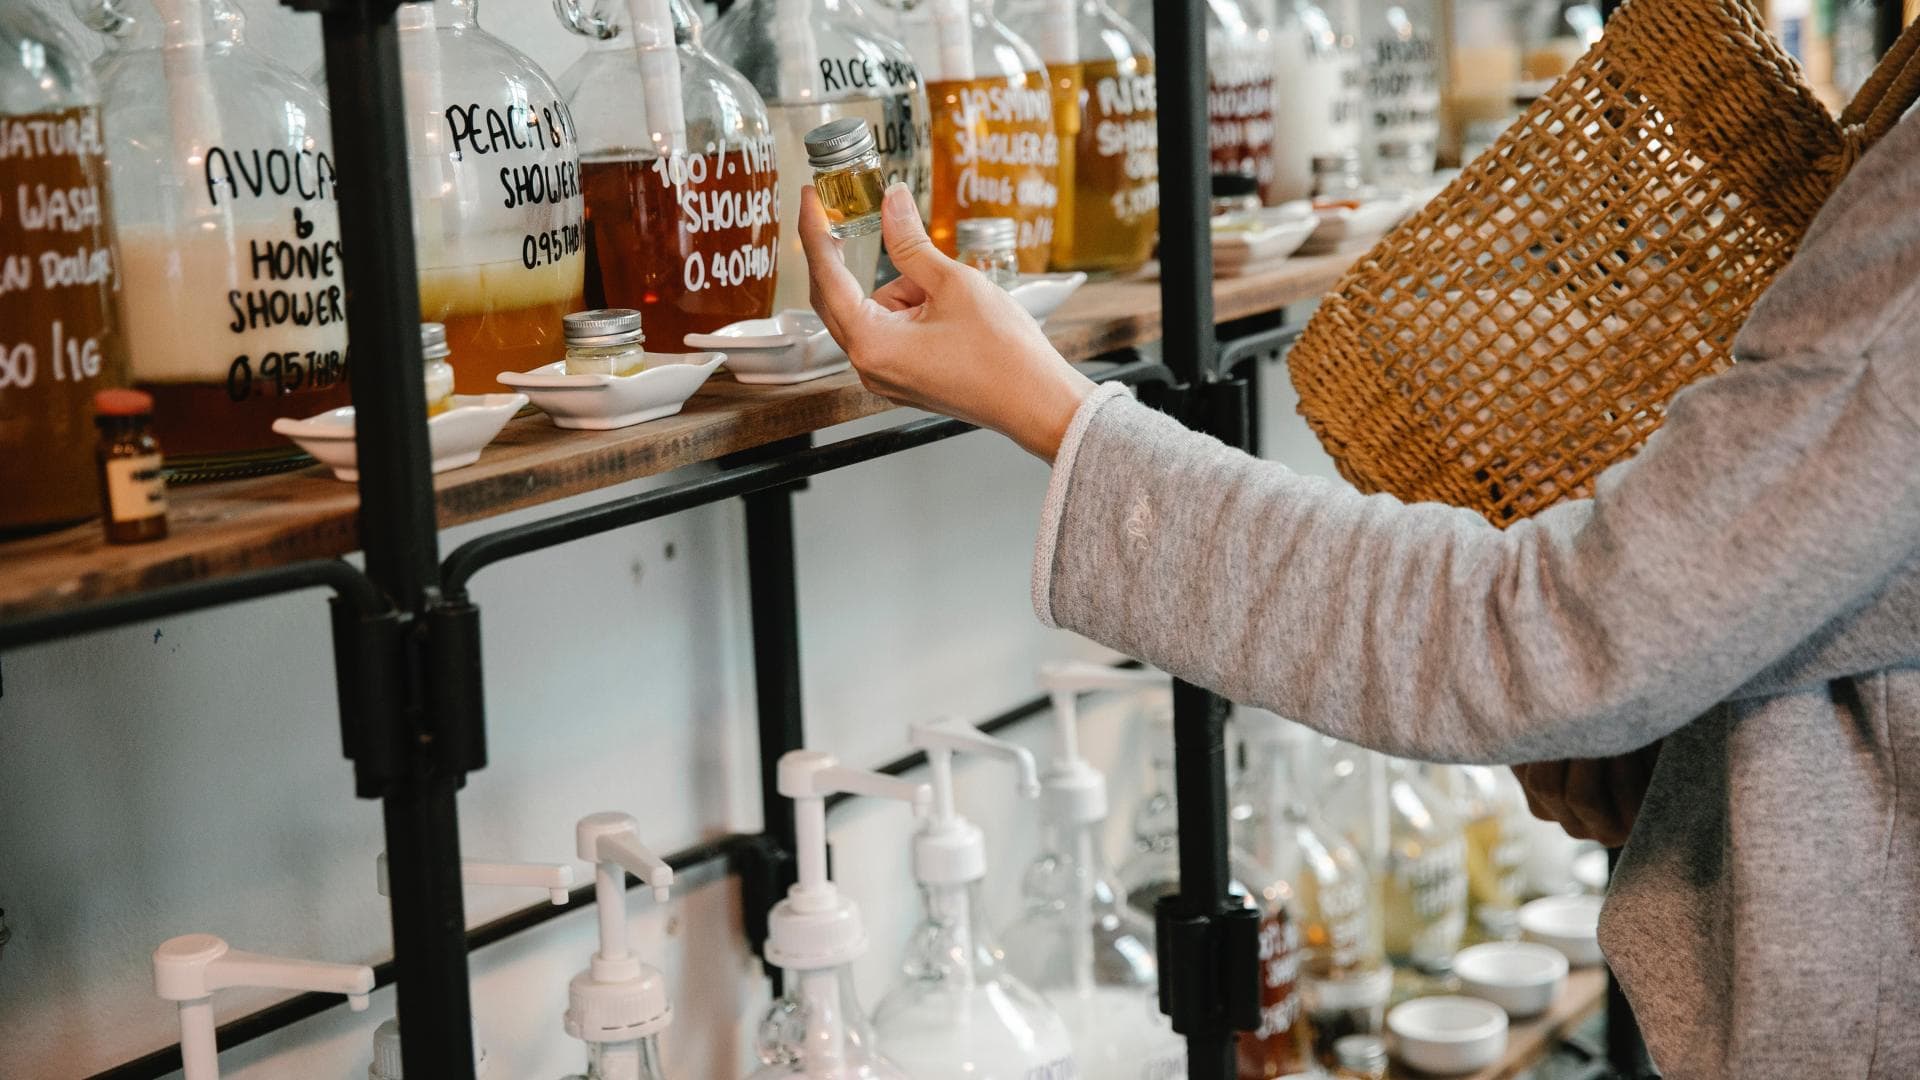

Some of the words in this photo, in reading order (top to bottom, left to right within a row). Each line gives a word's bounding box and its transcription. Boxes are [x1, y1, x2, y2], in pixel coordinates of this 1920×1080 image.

[819, 58, 877, 92] RICE
[445, 104, 545, 162] PEACH
[499, 159, 577, 209] SHOWER
[651, 138, 736, 189] 100%
[17, 183, 102, 232] WASH
[682, 187, 771, 234] SHOWER
[228, 285, 343, 335] SHOWER
